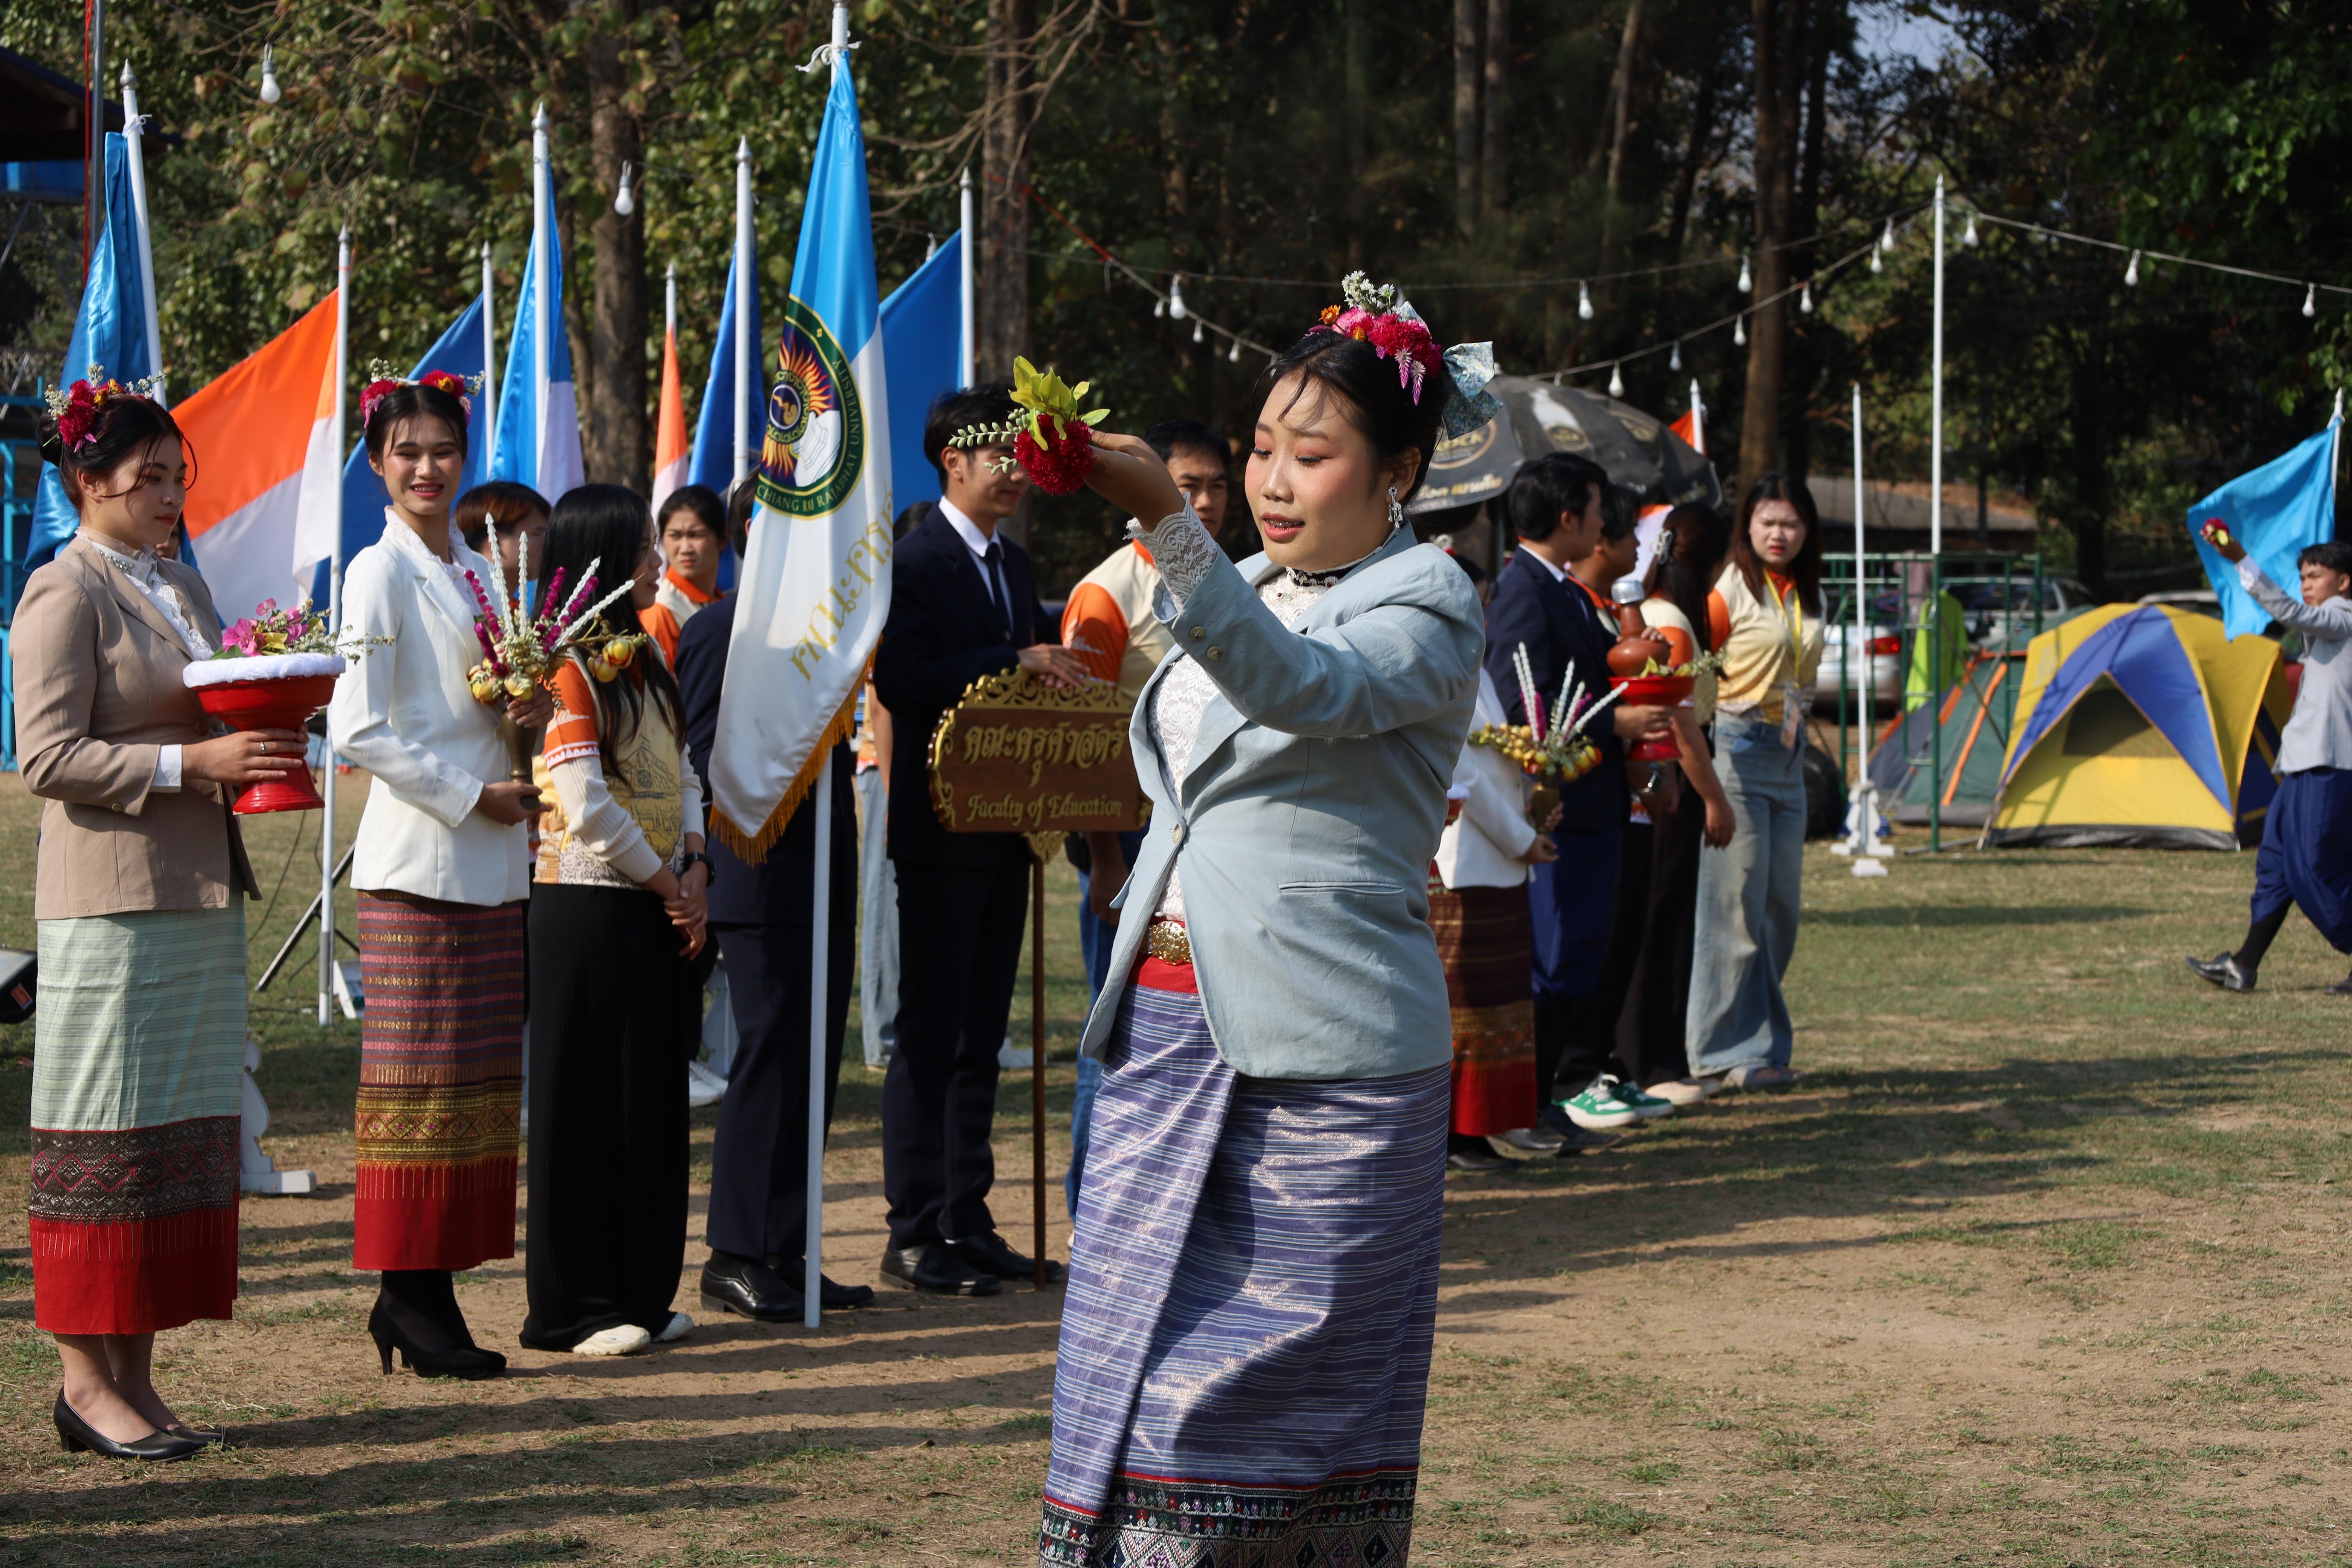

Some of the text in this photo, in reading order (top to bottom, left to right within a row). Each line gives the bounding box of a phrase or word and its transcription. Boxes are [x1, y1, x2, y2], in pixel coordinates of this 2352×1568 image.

[756, 358, 861, 512] CHIANG RAI RAJABHAT UNIVERSITY
[962, 718, 1130, 789] คณะครุศาสตร์
[966, 792, 1122, 827] Faculty of Education
